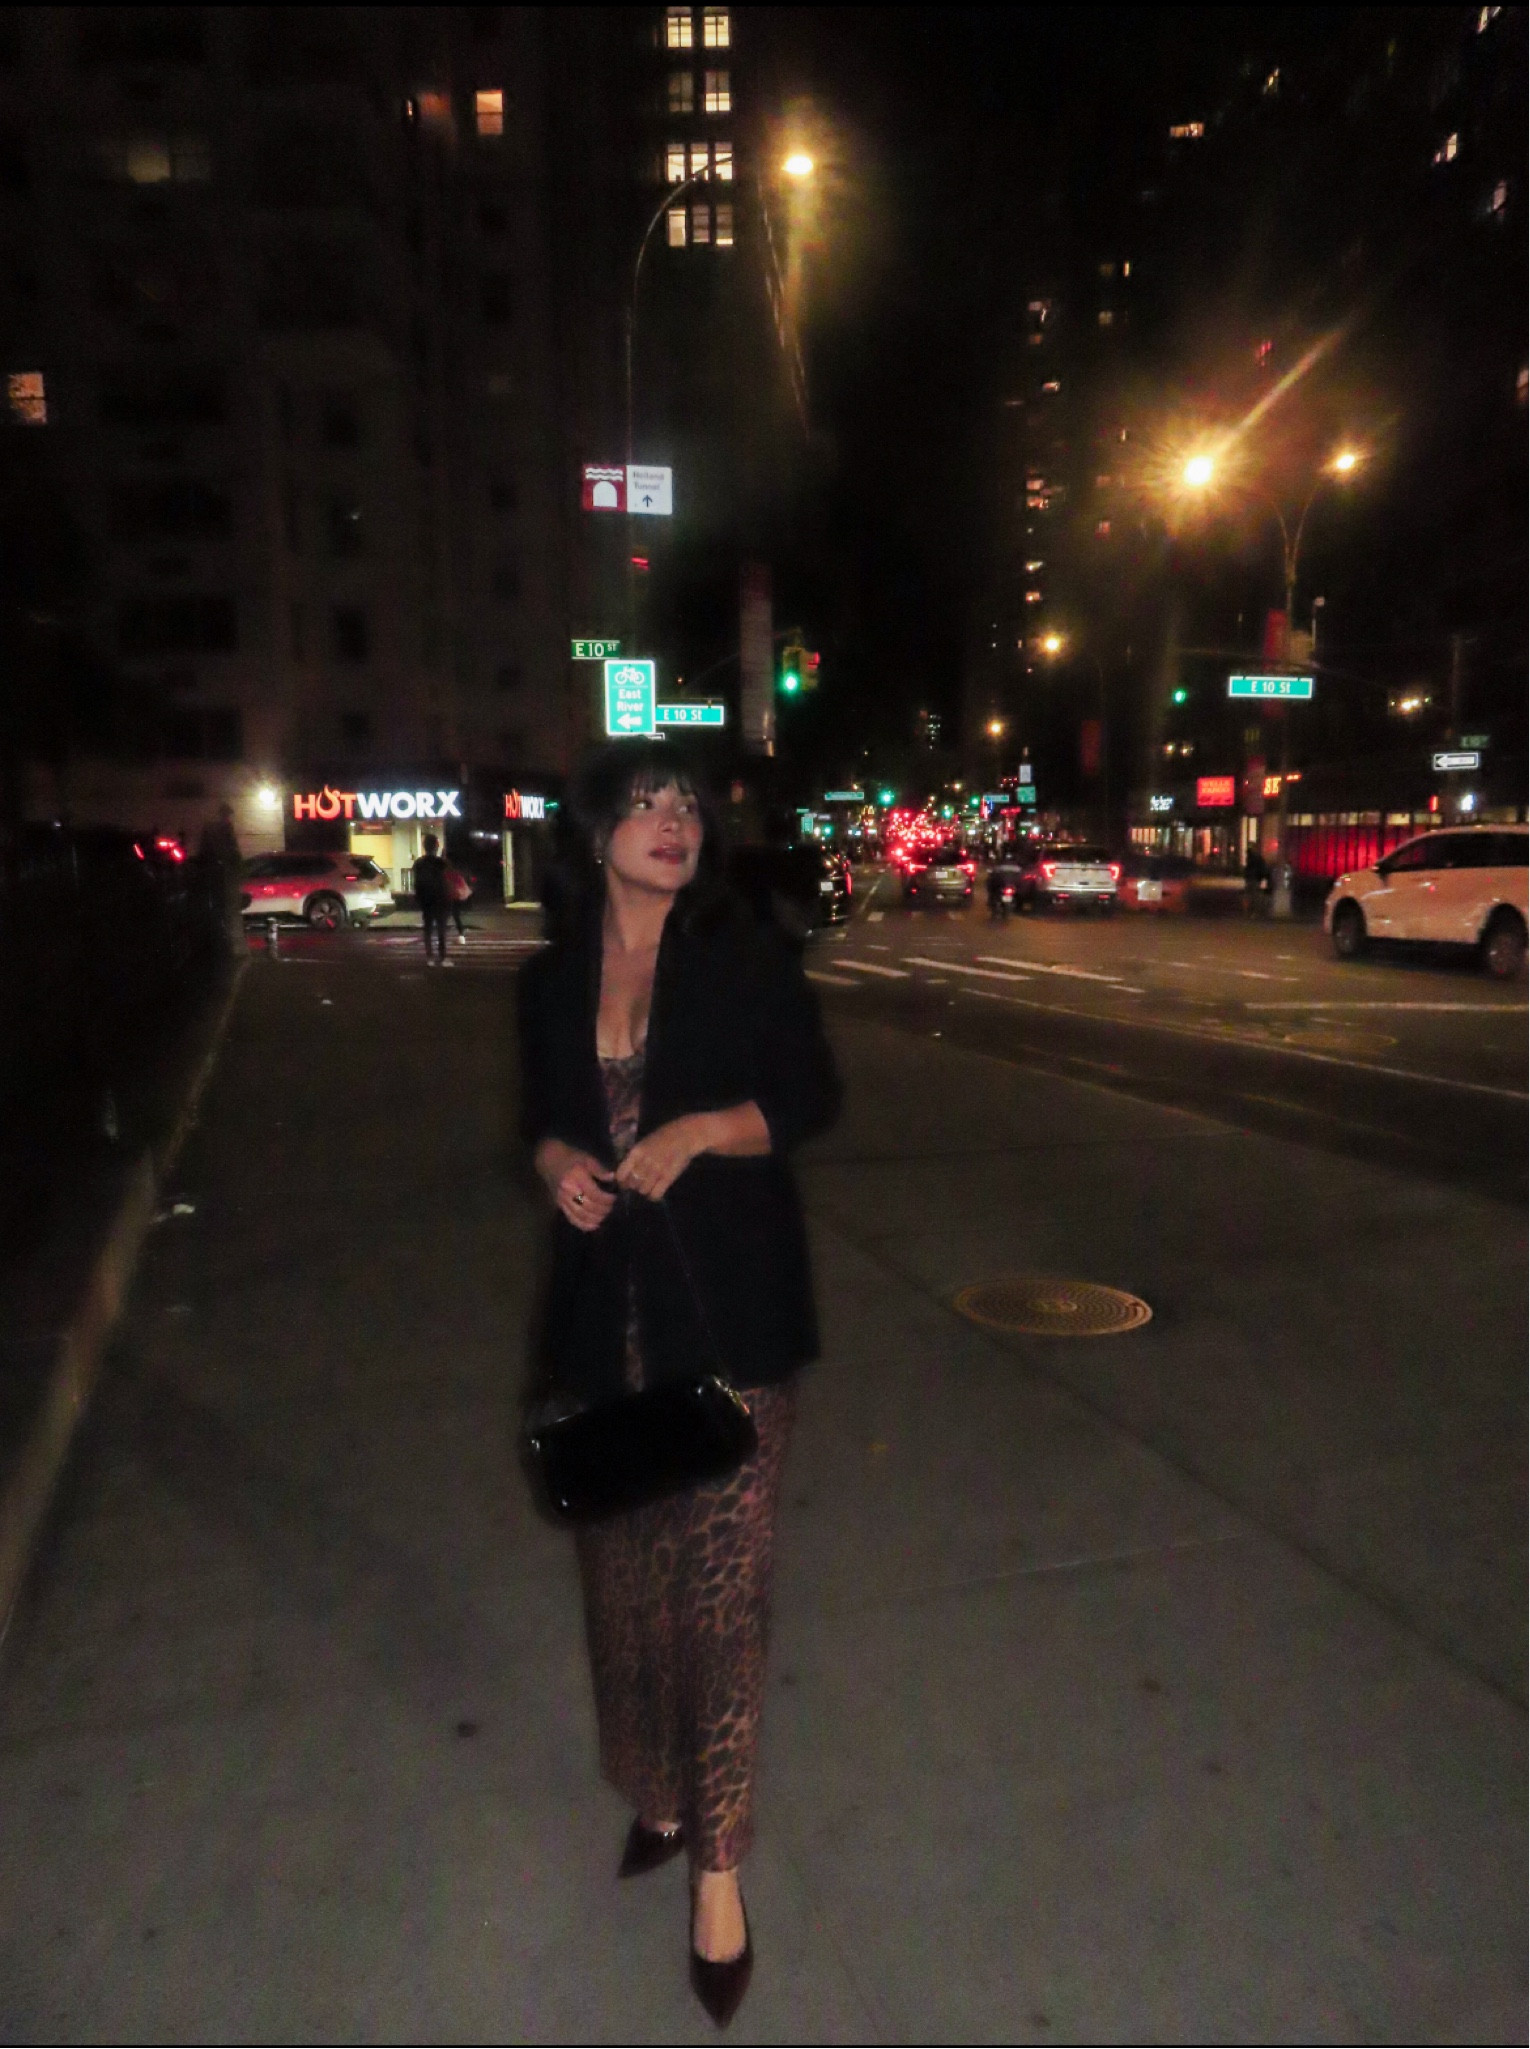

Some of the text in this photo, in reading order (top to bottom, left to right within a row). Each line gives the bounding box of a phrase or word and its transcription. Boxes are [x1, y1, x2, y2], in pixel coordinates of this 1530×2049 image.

[575, 643, 617, 657] E 10 ST
[1251, 681, 1291, 693] E 10 St
[619, 689, 642, 699] East
[616, 702, 644, 712] River
[663, 710, 702, 720] E 10 St
[293, 784, 462, 820] HOTWORX
